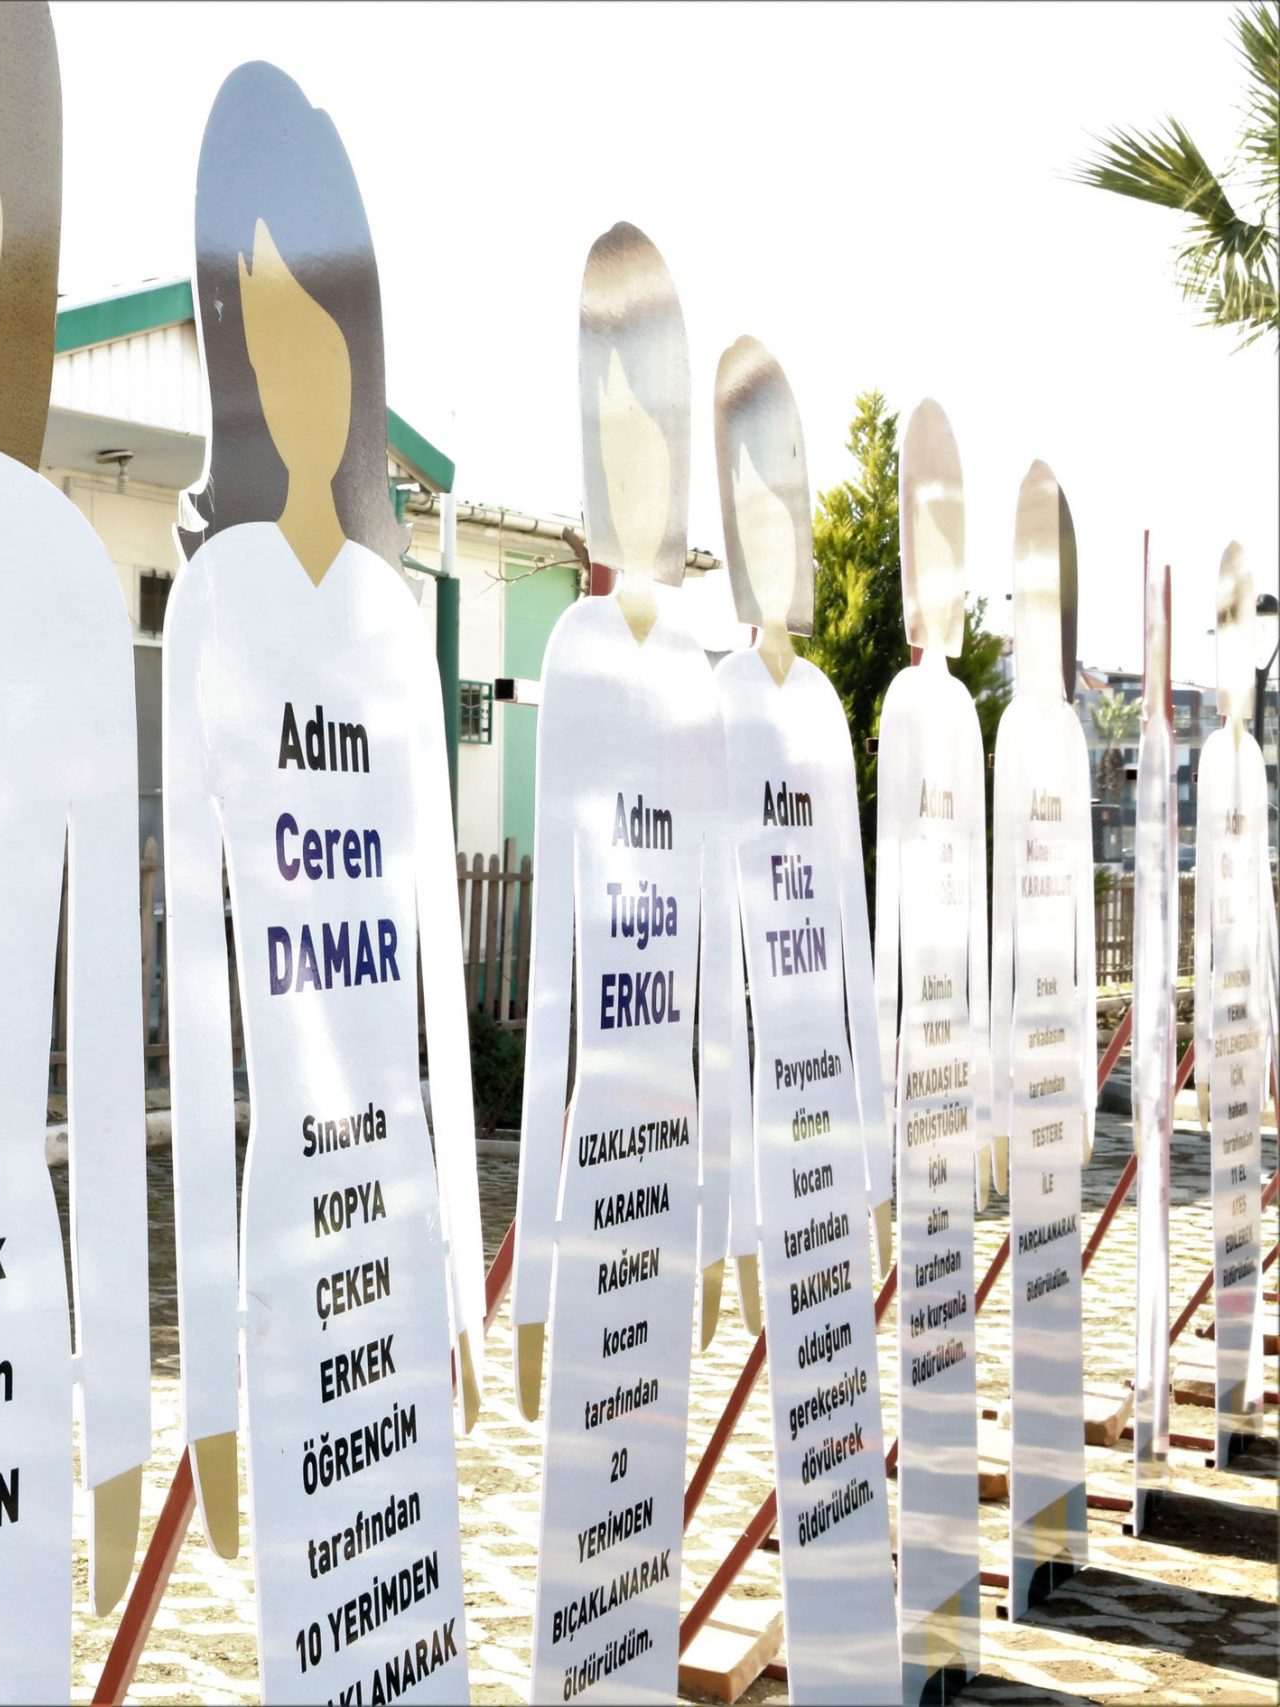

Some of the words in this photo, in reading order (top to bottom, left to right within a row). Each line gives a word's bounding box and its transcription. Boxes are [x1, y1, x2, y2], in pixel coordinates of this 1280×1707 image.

[279, 702, 370, 773] Adım
[612, 792, 673, 850] Adım
[763, 780, 813, 827] Adım
[919, 778, 953, 821] Adım
[1030, 787, 1062, 822] Adım
[276, 812, 383, 881] Ceren
[771, 854, 814, 902] Filiz
[607, 880, 677, 951] Tuğba
[268, 918, 401, 995] DAMAR
[766, 917, 827, 978] TEKİN
[600, 970, 680, 1030] ERKOL
[921, 976, 953, 1002] Abimin
[923, 1019, 951, 1048] YAKIN
[774, 1048, 842, 1092] Pavyondan
[953, 1057, 968, 1089] İLE
[302, 1102, 387, 1157] Sınavda
[578, 1116, 690, 1168] UZAKLAŞTIRMA
[791, 1108, 830, 1143] dönen
[594, 1182, 670, 1231] KARARINA
[792, 1161, 834, 1200] kocam
[313, 1179, 387, 1238] KOPYA
[784, 1211, 849, 1259] tarafından
[927, 1208, 949, 1236] abim
[316, 1256, 391, 1330] ÇEKEN
[598, 1247, 659, 1295] RAĞMEN
[790, 1260, 851, 1316] BAKIMSIZ
[915, 1249, 961, 1289] tarafından
[602, 1318, 648, 1359] kocam
[798, 1320, 851, 1369] olduğum
[910, 1313, 925, 1339] tek
[320, 1334, 396, 1404] ERKEK
[584, 1376, 659, 1431] tarafından
[789, 1367, 868, 1441] gerekçesiyle
[302, 1402, 418, 1495] ÖĞRENCİM
[610, 1448, 628, 1483] 20
[801, 1422, 864, 1486] dövülerek
[308, 1490, 421, 1579] tarafından
[577, 1497, 653, 1563] YERİMDEN
[798, 1477, 874, 1548] öldürüldüm.
[296, 1622, 322, 1673] 10
[327, 1550, 440, 1654] YERİMDEN
[552, 1549, 671, 1644] BIÇAKLANARAK
[563, 1625, 653, 1702] öldürüldüm.
